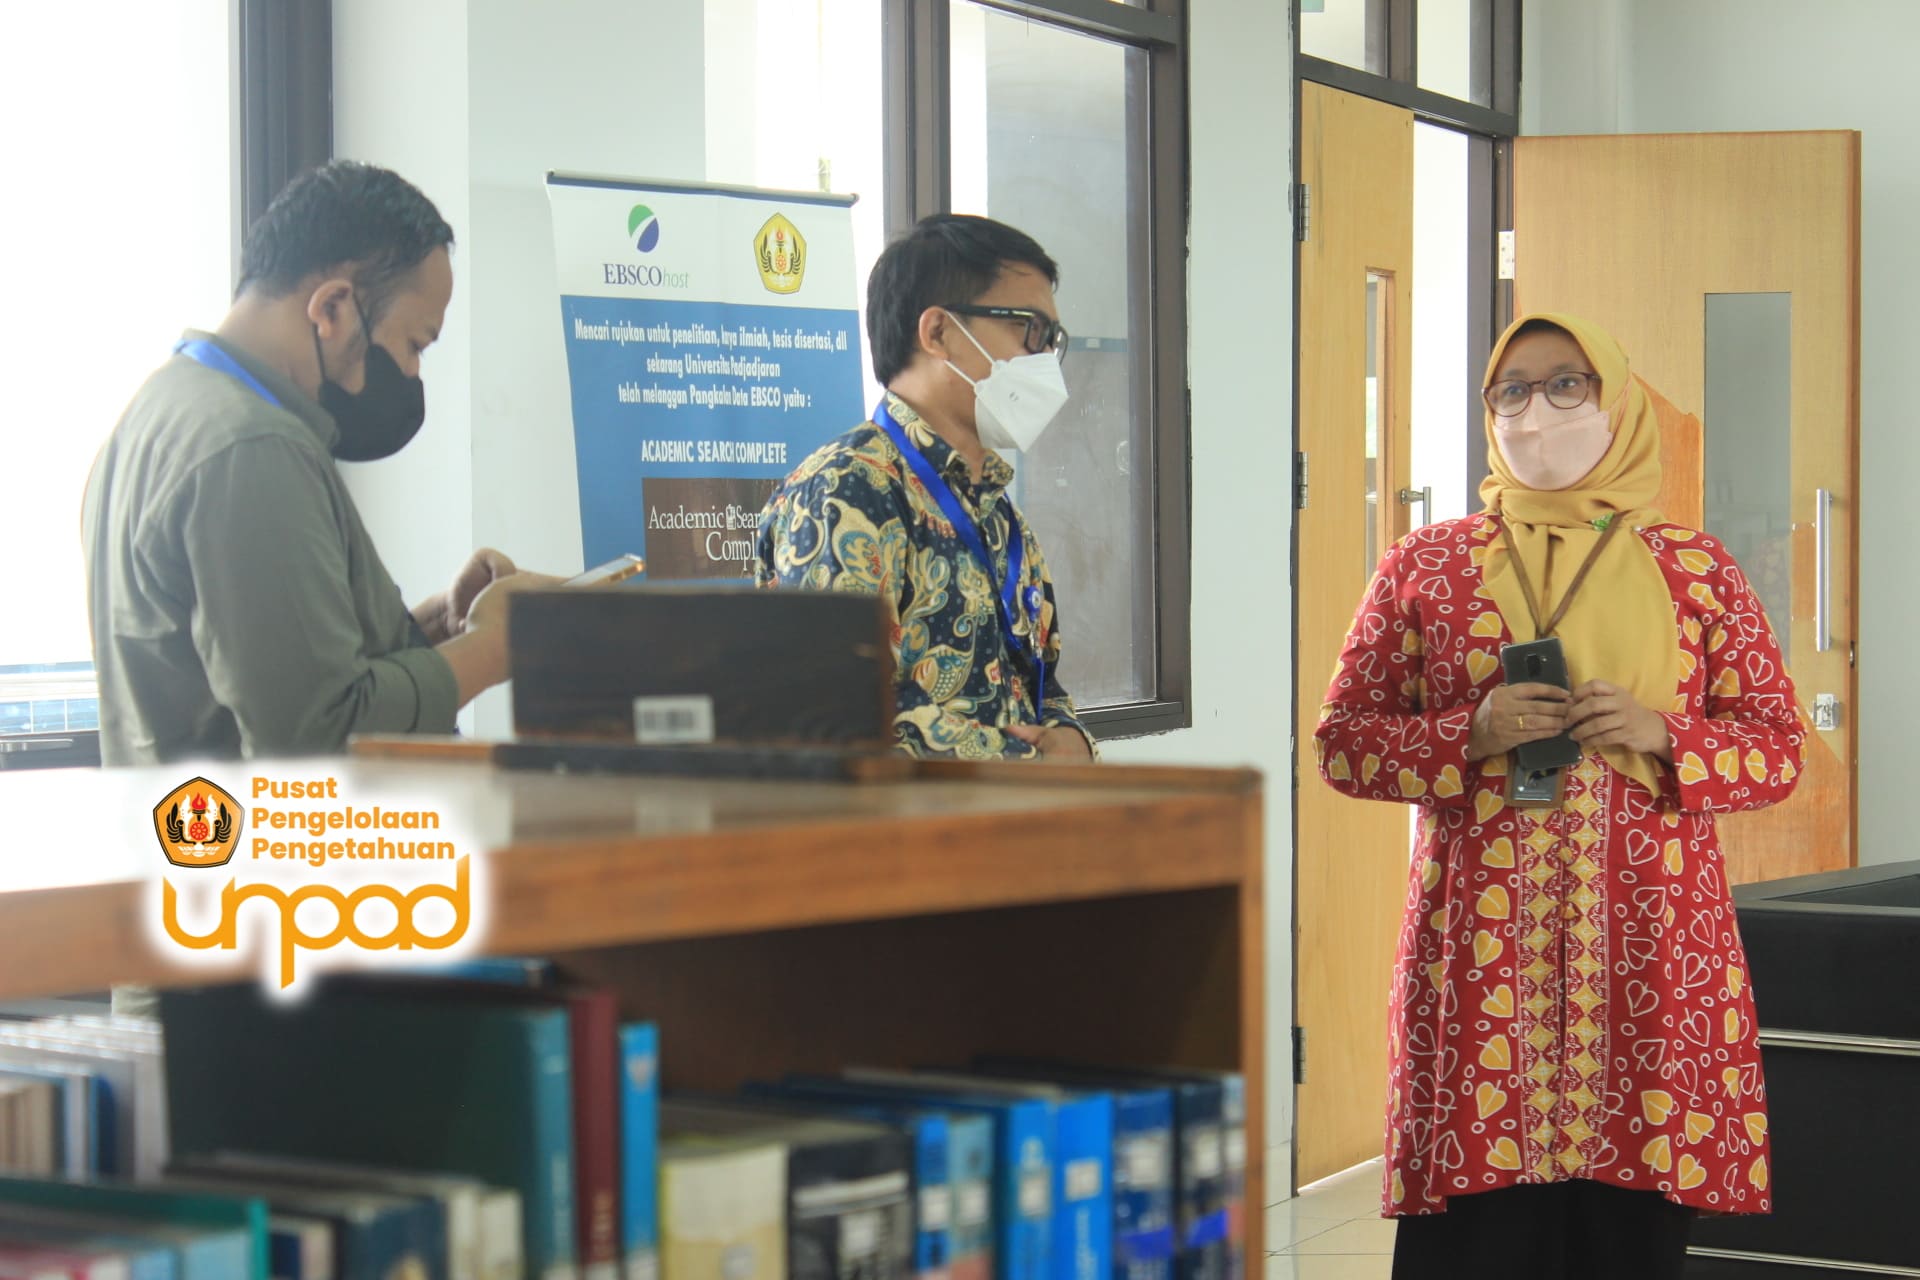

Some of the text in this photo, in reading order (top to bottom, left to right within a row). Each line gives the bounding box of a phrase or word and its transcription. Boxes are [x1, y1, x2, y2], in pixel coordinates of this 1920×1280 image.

[603, 263, 689, 289] EBSCOhost
[575, 318, 609, 340] Mencari
[612, 320, 645, 347] rujukan
[647, 321, 671, 343] untuk
[673, 323, 719, 349] penelitian,
[739, 325, 771, 351] ilmiah,
[773, 328, 792, 349] tesis
[795, 328, 834, 353] disertasi,
[836, 330, 847, 351] dll
[647, 351, 683, 379] sekarang
[731, 355, 780, 382] Padjadjaran
[619, 381, 640, 403] telah
[643, 382, 688, 408] melanggan
[732, 384, 748, 406] Data
[751, 386, 780, 407] EBSCO
[783, 387, 805, 412] yaitu
[642, 439, 787, 464] ACADEMIC SEARCH COMPLETE
[648, 504, 760, 529] Academic Sear
[706, 531, 757, 571] Compl
